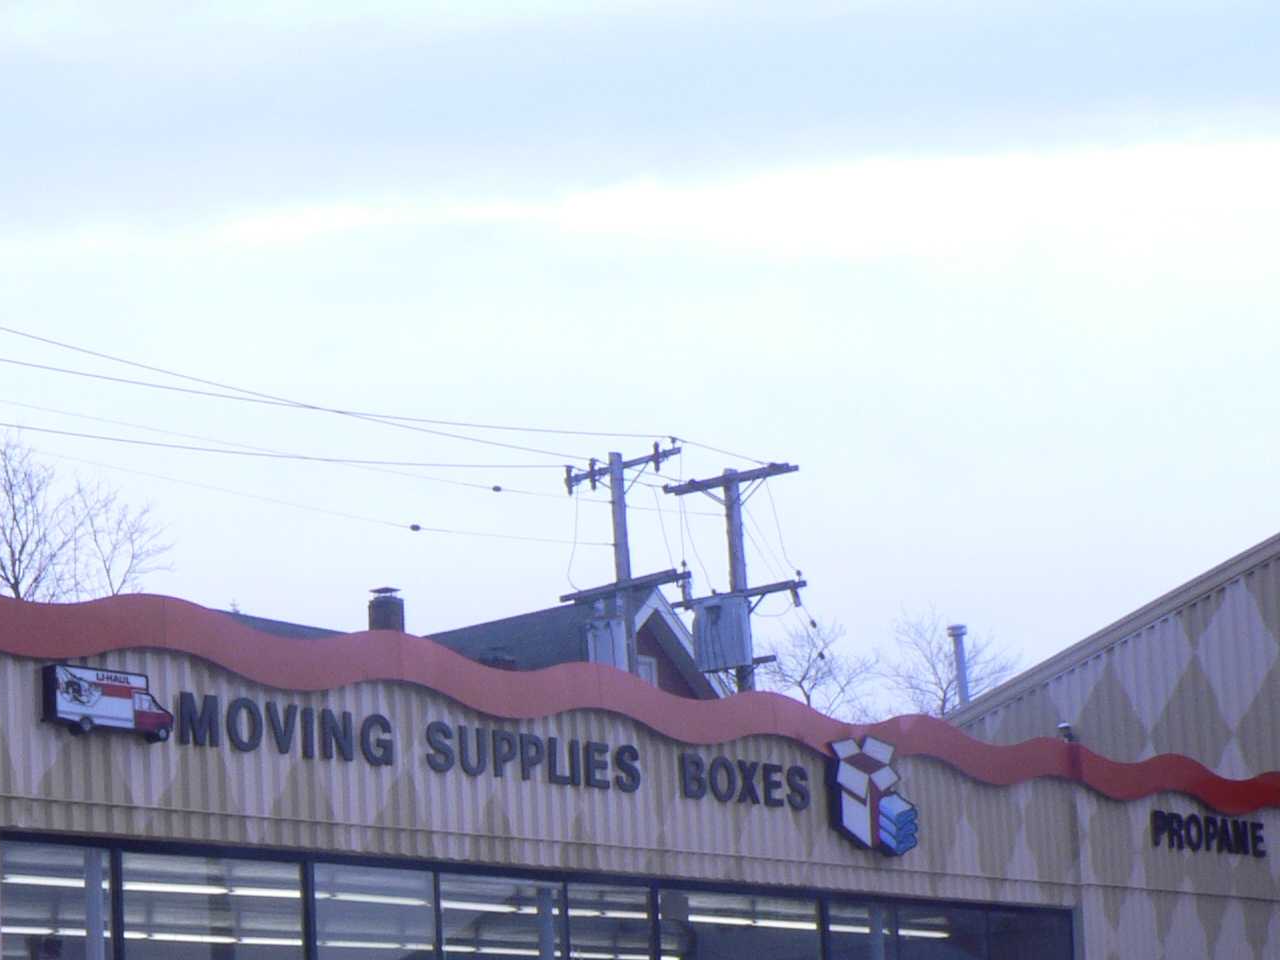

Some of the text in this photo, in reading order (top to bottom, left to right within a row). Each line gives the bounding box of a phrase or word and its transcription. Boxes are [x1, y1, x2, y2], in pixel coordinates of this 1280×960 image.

[179, 690, 811, 811] MOVING SUPPLIES BOXES
[1151, 809, 1266, 858] PROPANE
